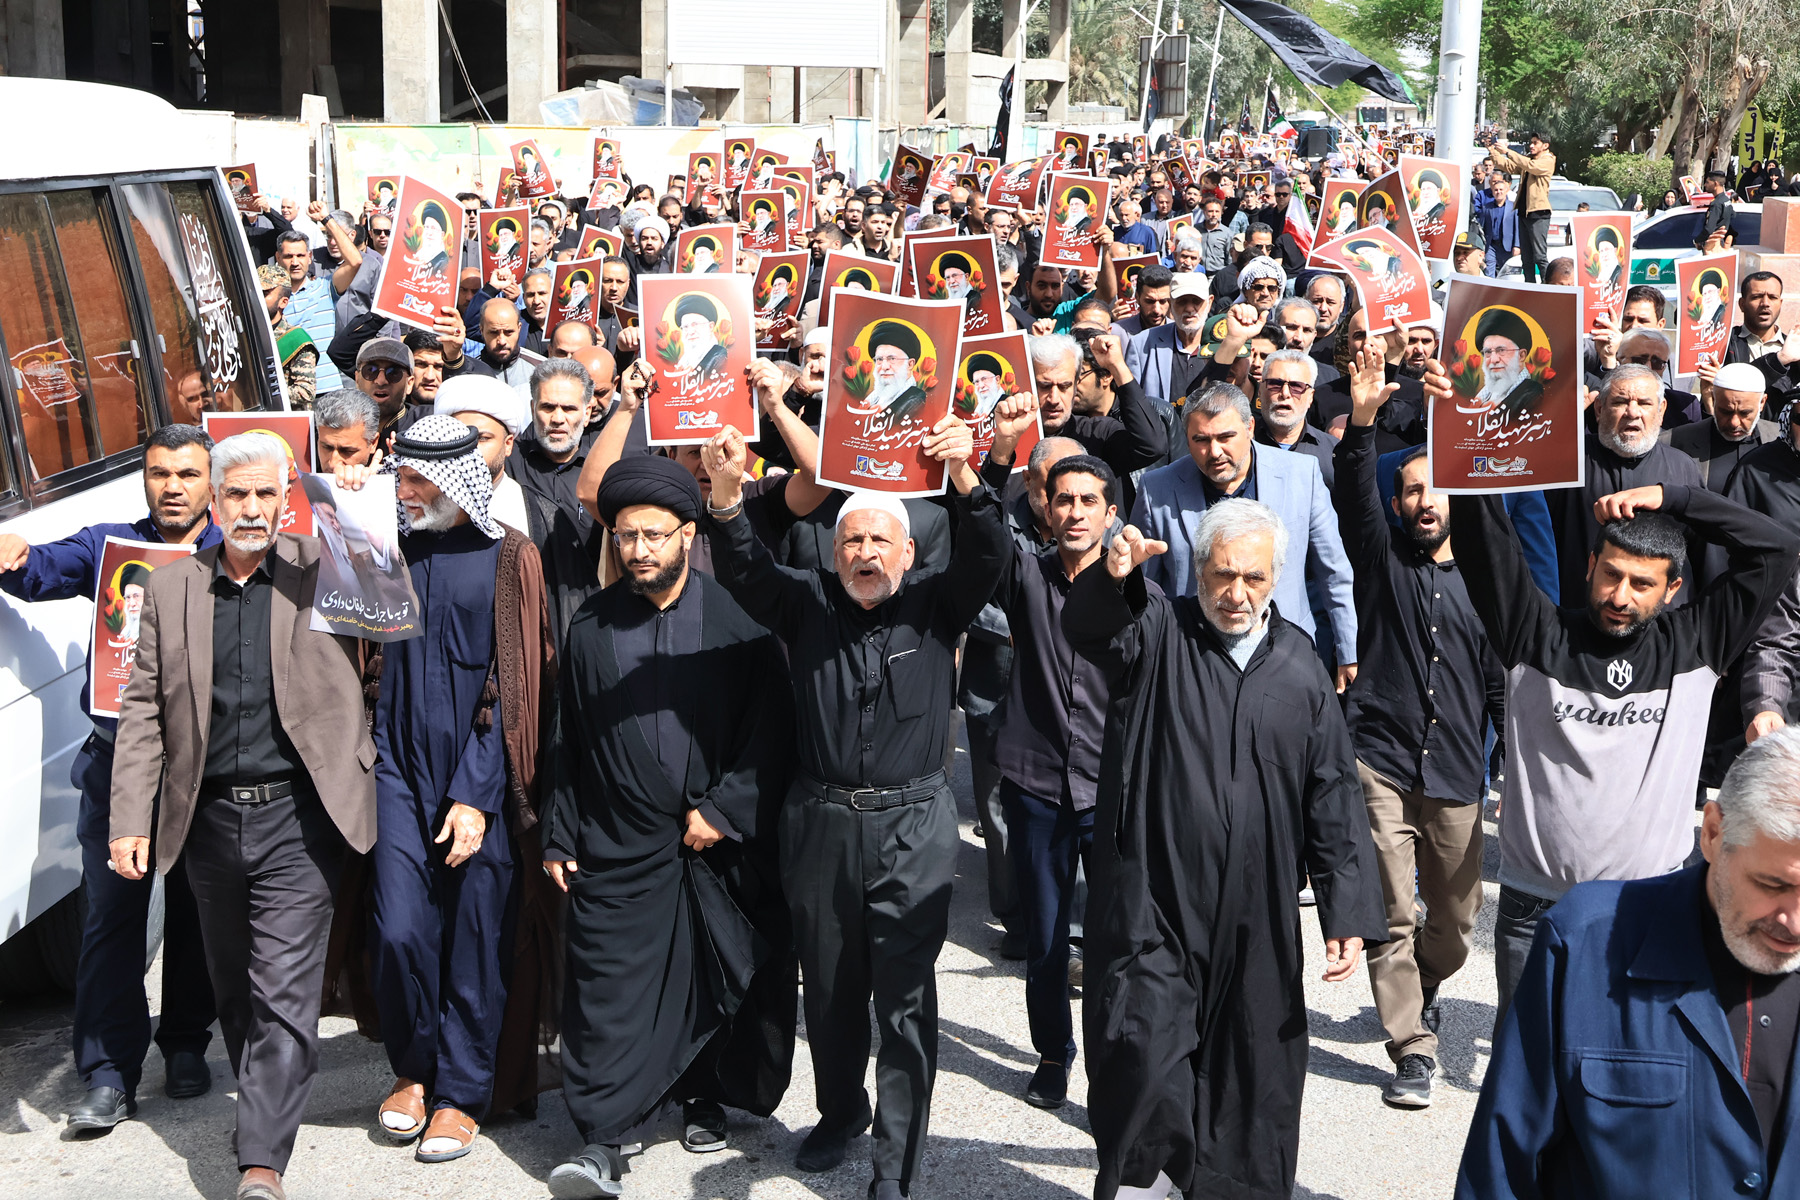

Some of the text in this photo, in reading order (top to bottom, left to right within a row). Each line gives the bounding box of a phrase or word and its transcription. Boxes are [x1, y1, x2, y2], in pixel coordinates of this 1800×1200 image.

[663, 366, 736, 404] رهبر شهید انقلاب
[846, 402, 896, 438] انقلاب
[873, 414, 914, 451] شهید
[1455, 402, 1553, 449] رهبر شهید انقلاب
[321, 590, 345, 609] دادی
[386, 607, 394, 620] ما
[402, 601, 410, 619] تو
